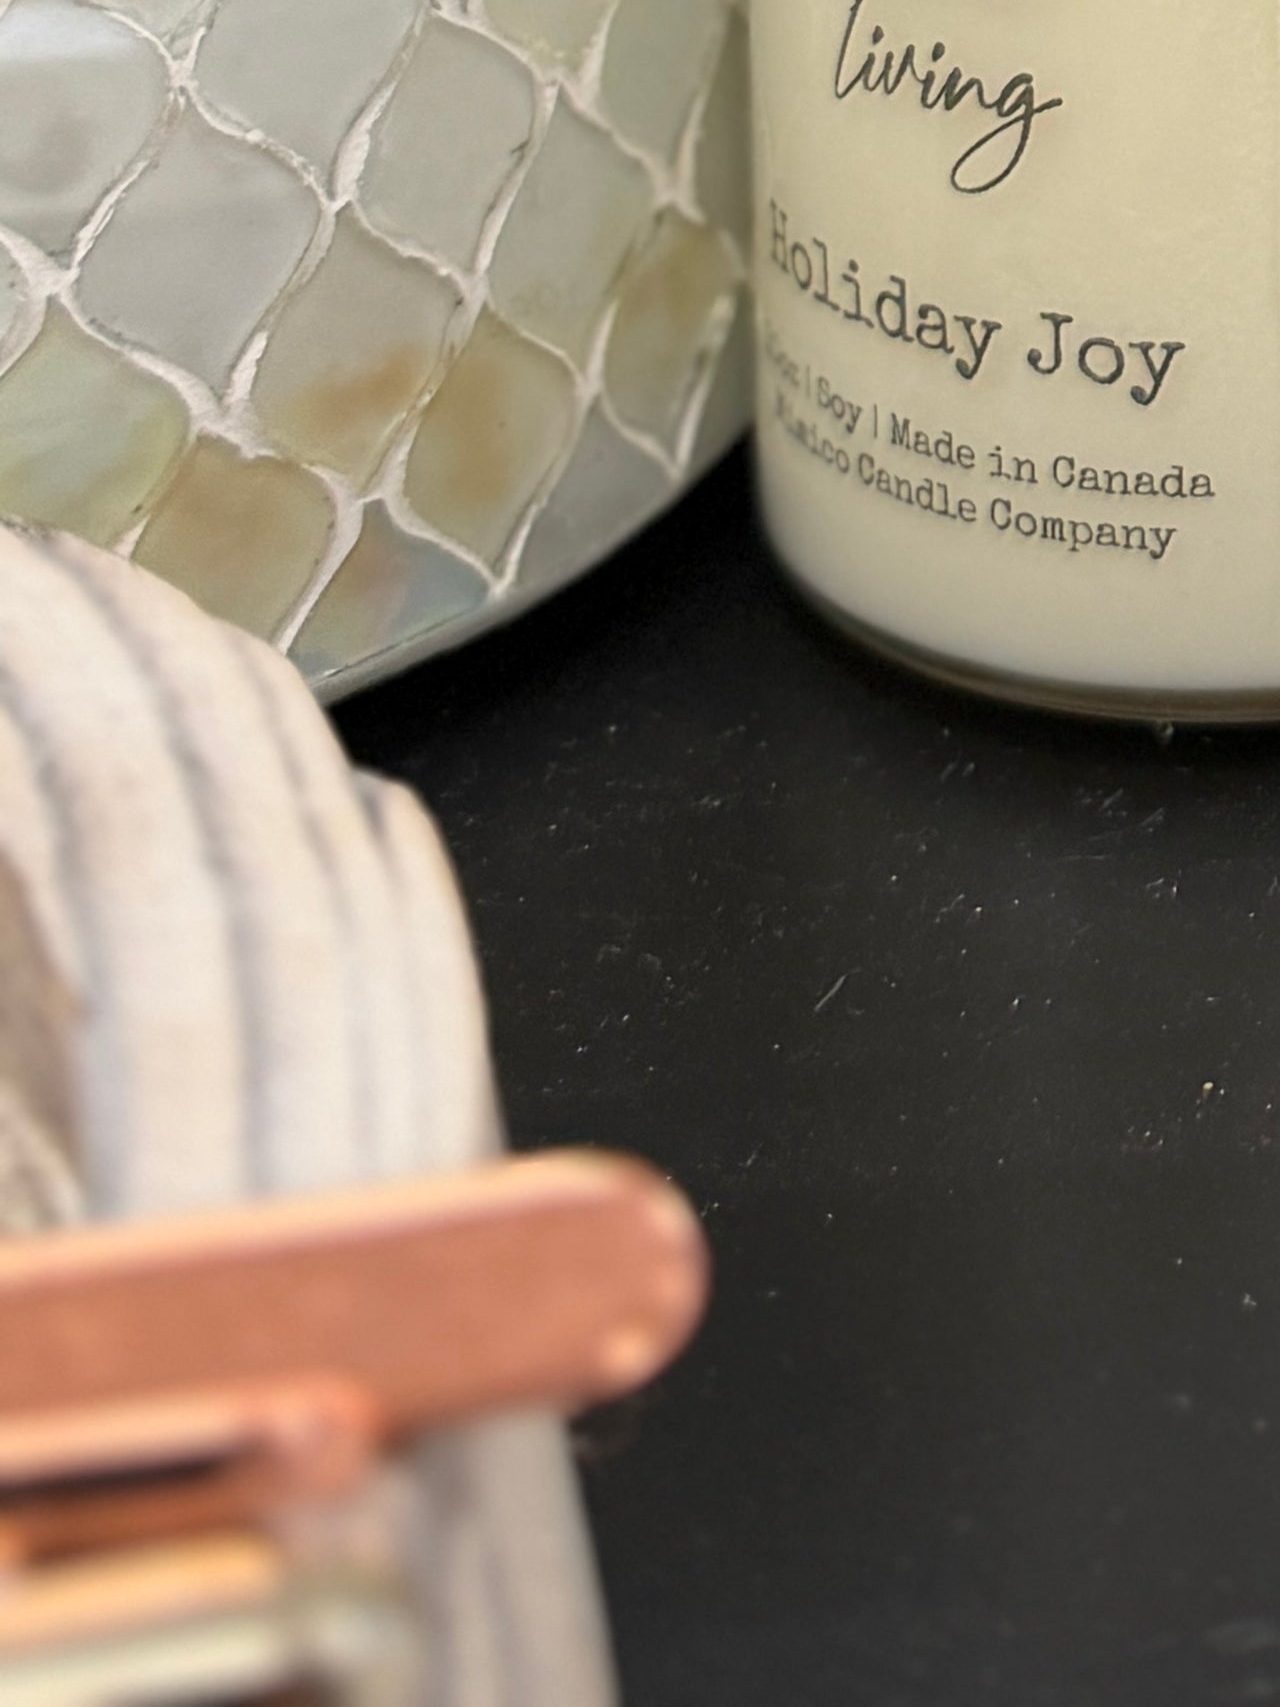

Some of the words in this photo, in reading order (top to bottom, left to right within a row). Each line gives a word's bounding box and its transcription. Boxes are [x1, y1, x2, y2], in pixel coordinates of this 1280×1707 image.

[770, 200, 1003, 384] Holiday
[1026, 311, 1187, 407] Joy
[818, 377, 862, 435] Soy
[890, 412, 976, 471] Made
[987, 445, 1039, 485] in
[1051, 455, 1216, 500] Canada
[857, 453, 977, 524] Candle
[989, 497, 1178, 561] Company
